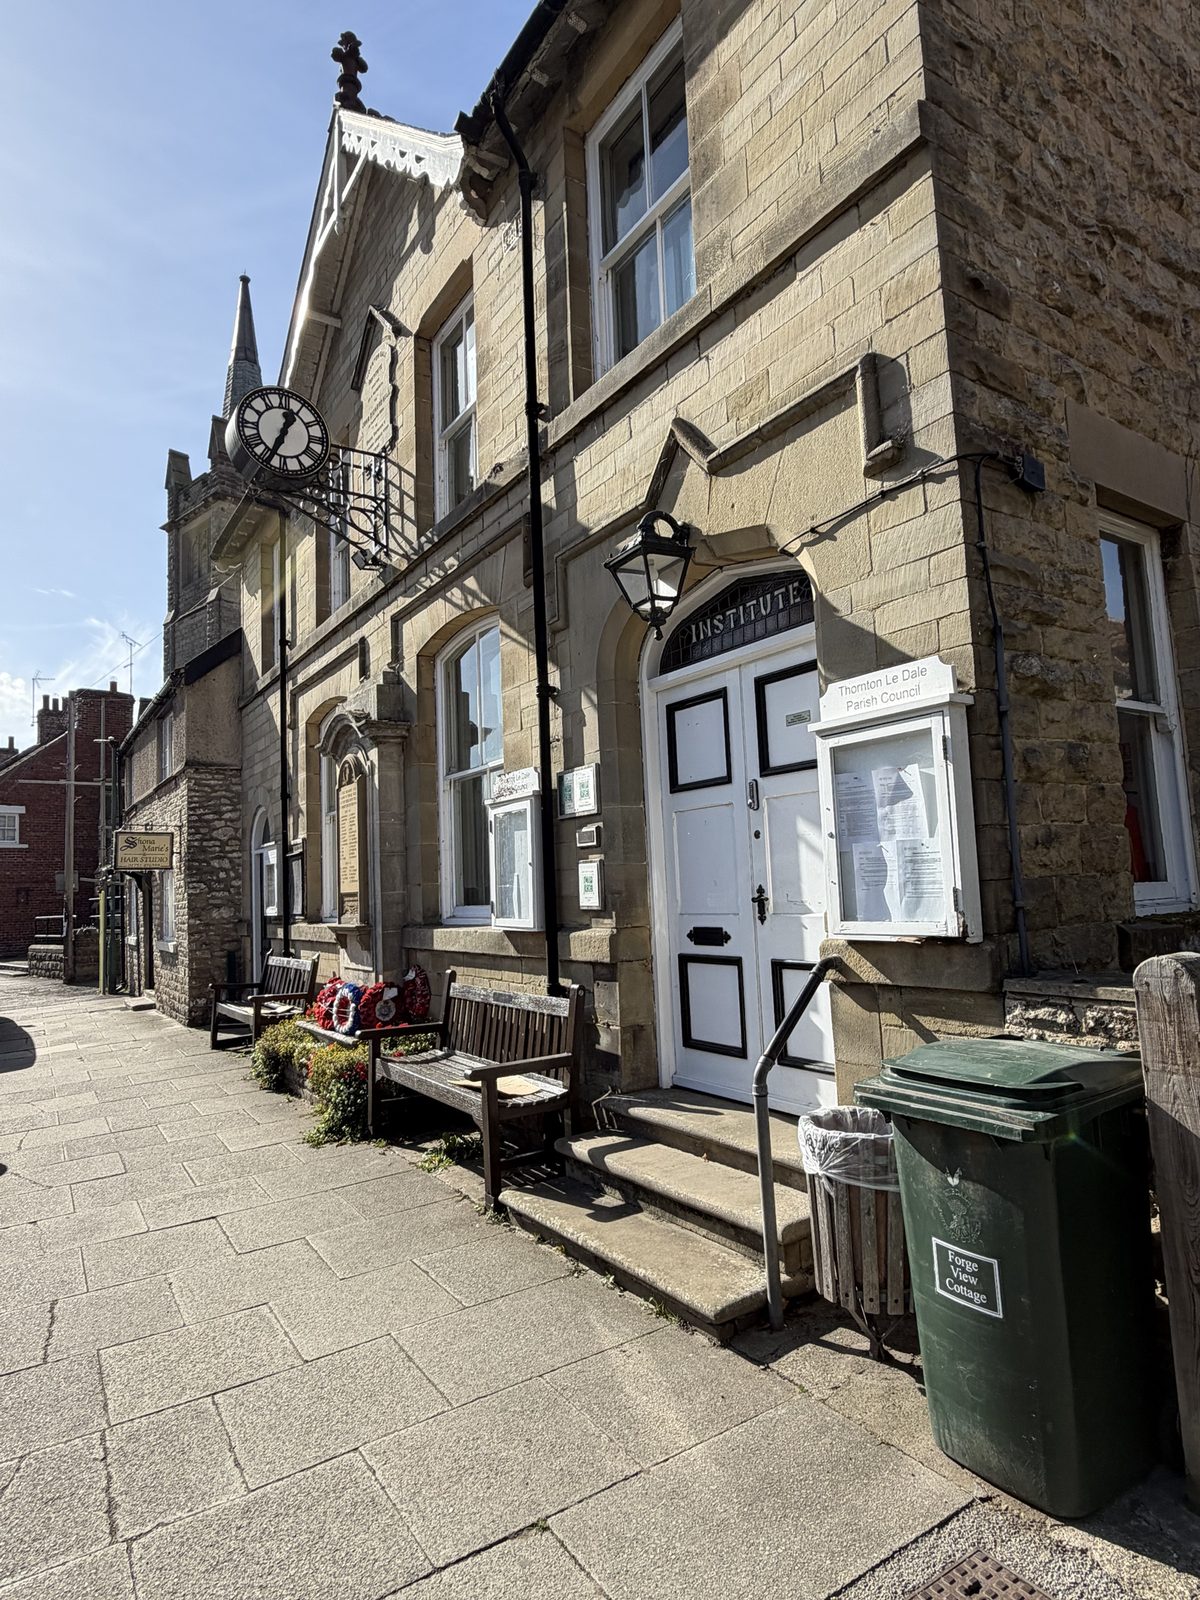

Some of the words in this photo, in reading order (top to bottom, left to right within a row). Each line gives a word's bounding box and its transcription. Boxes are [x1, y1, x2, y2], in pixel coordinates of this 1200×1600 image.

[278, 394, 290, 410] XII
[306, 419, 319, 428] II
[308, 434, 324, 446] III
[691, 581, 801, 643] INSTITUTE
[838, 678, 882, 697] Thornton
[885, 674, 899, 686] Le
[901, 666, 928, 681] Dale
[846, 694, 878, 711] Parish
[880, 682, 921, 704] Council
[120, 836, 155, 851] Shona
[948, 1250, 979, 1273] Forge
[950, 1264, 978, 1285] View
[945, 1278, 988, 1304] Cottage
